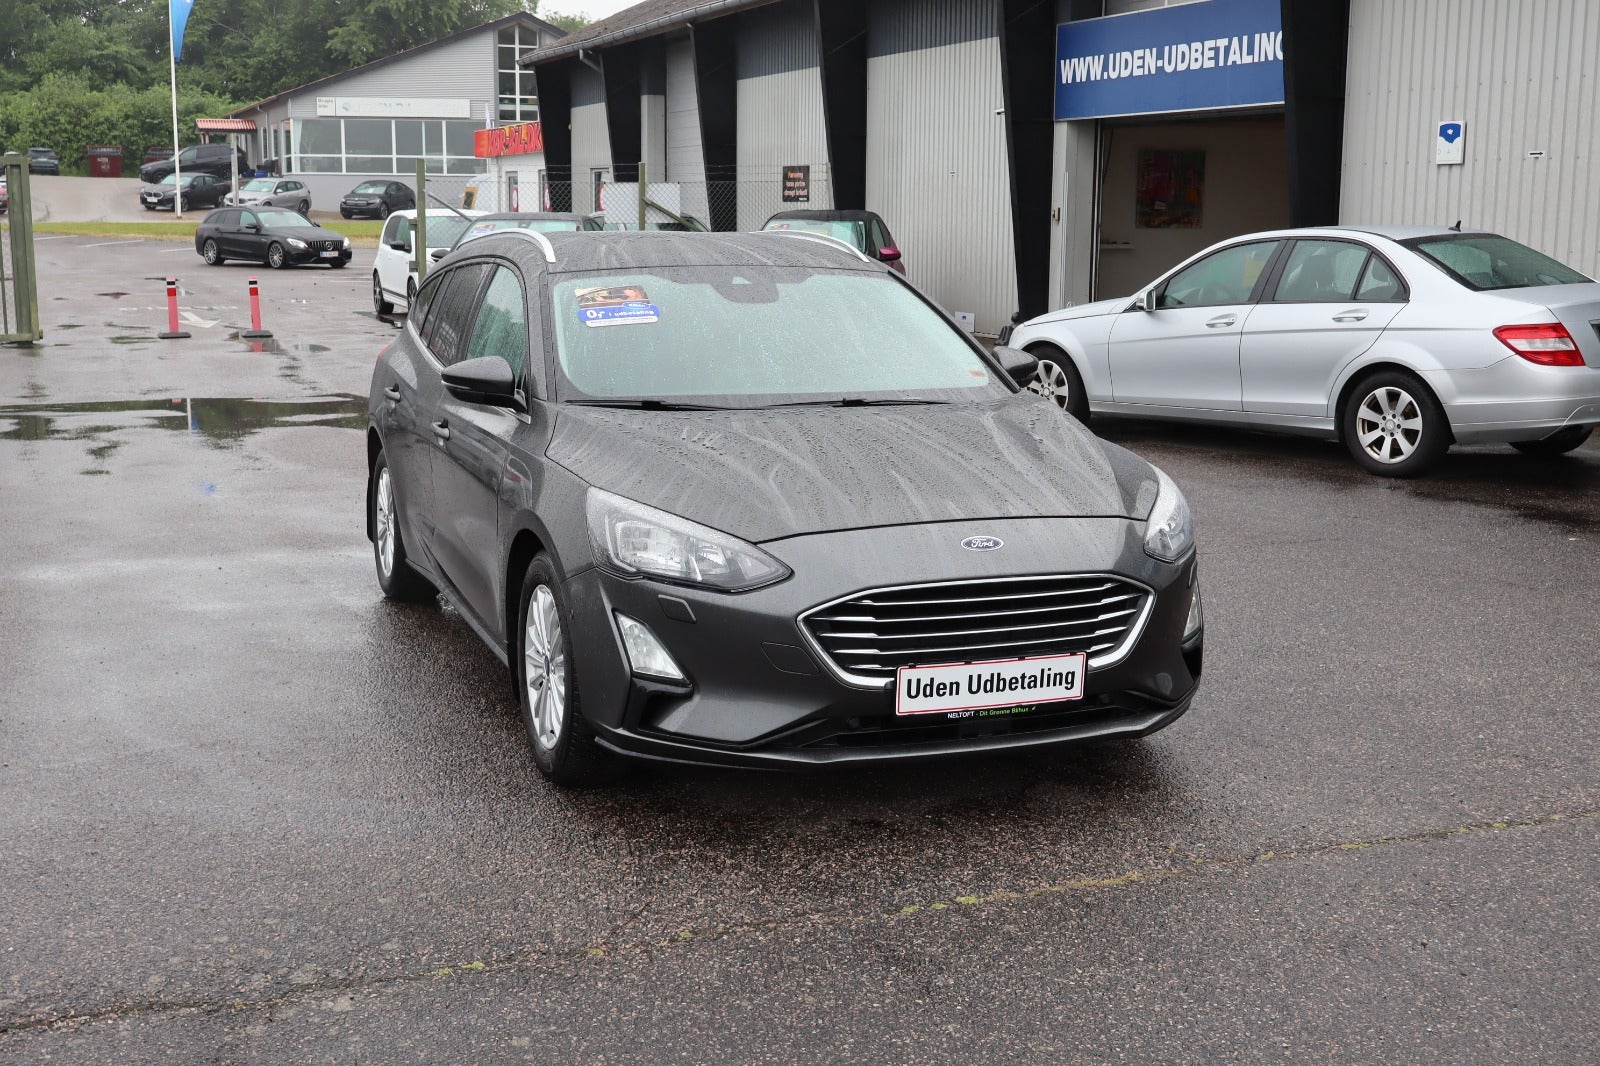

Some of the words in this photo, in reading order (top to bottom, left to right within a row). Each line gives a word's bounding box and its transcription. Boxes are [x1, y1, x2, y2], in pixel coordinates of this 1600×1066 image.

[971, 538, 995, 549] Ford
[906, 678, 960, 700] Uden
[967, 668, 1076, 694] Udbetaling
[947, 710, 975, 719] NELTOFT
